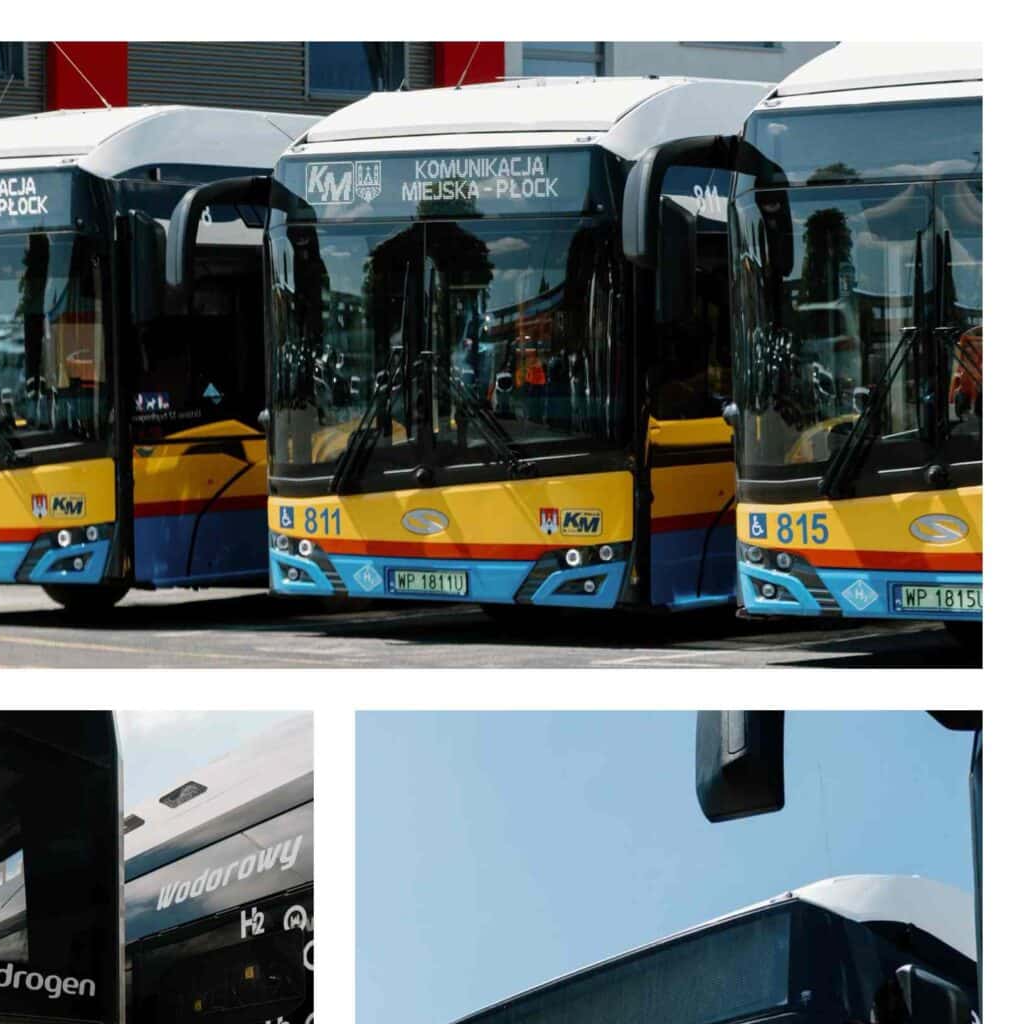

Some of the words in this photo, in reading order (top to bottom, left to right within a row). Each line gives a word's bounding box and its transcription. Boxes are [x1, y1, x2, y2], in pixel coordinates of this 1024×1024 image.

[415, 156, 545, 180] KOMUNIKACJA
[307, 165, 353, 202] KM
[401, 179, 479, 202] MIEJSKA
[495, 177, 558, 200] PŁOCK
[51, 496, 84, 515] KM
[304, 507, 341, 535] 811
[563, 511, 601, 534] KM
[776, 512, 829, 544] 815
[397, 574, 417, 589] WP
[422, 575, 466, 593] 1811U
[905, 589, 927, 606] WP
[156, 834, 303, 911] Wodorowy
